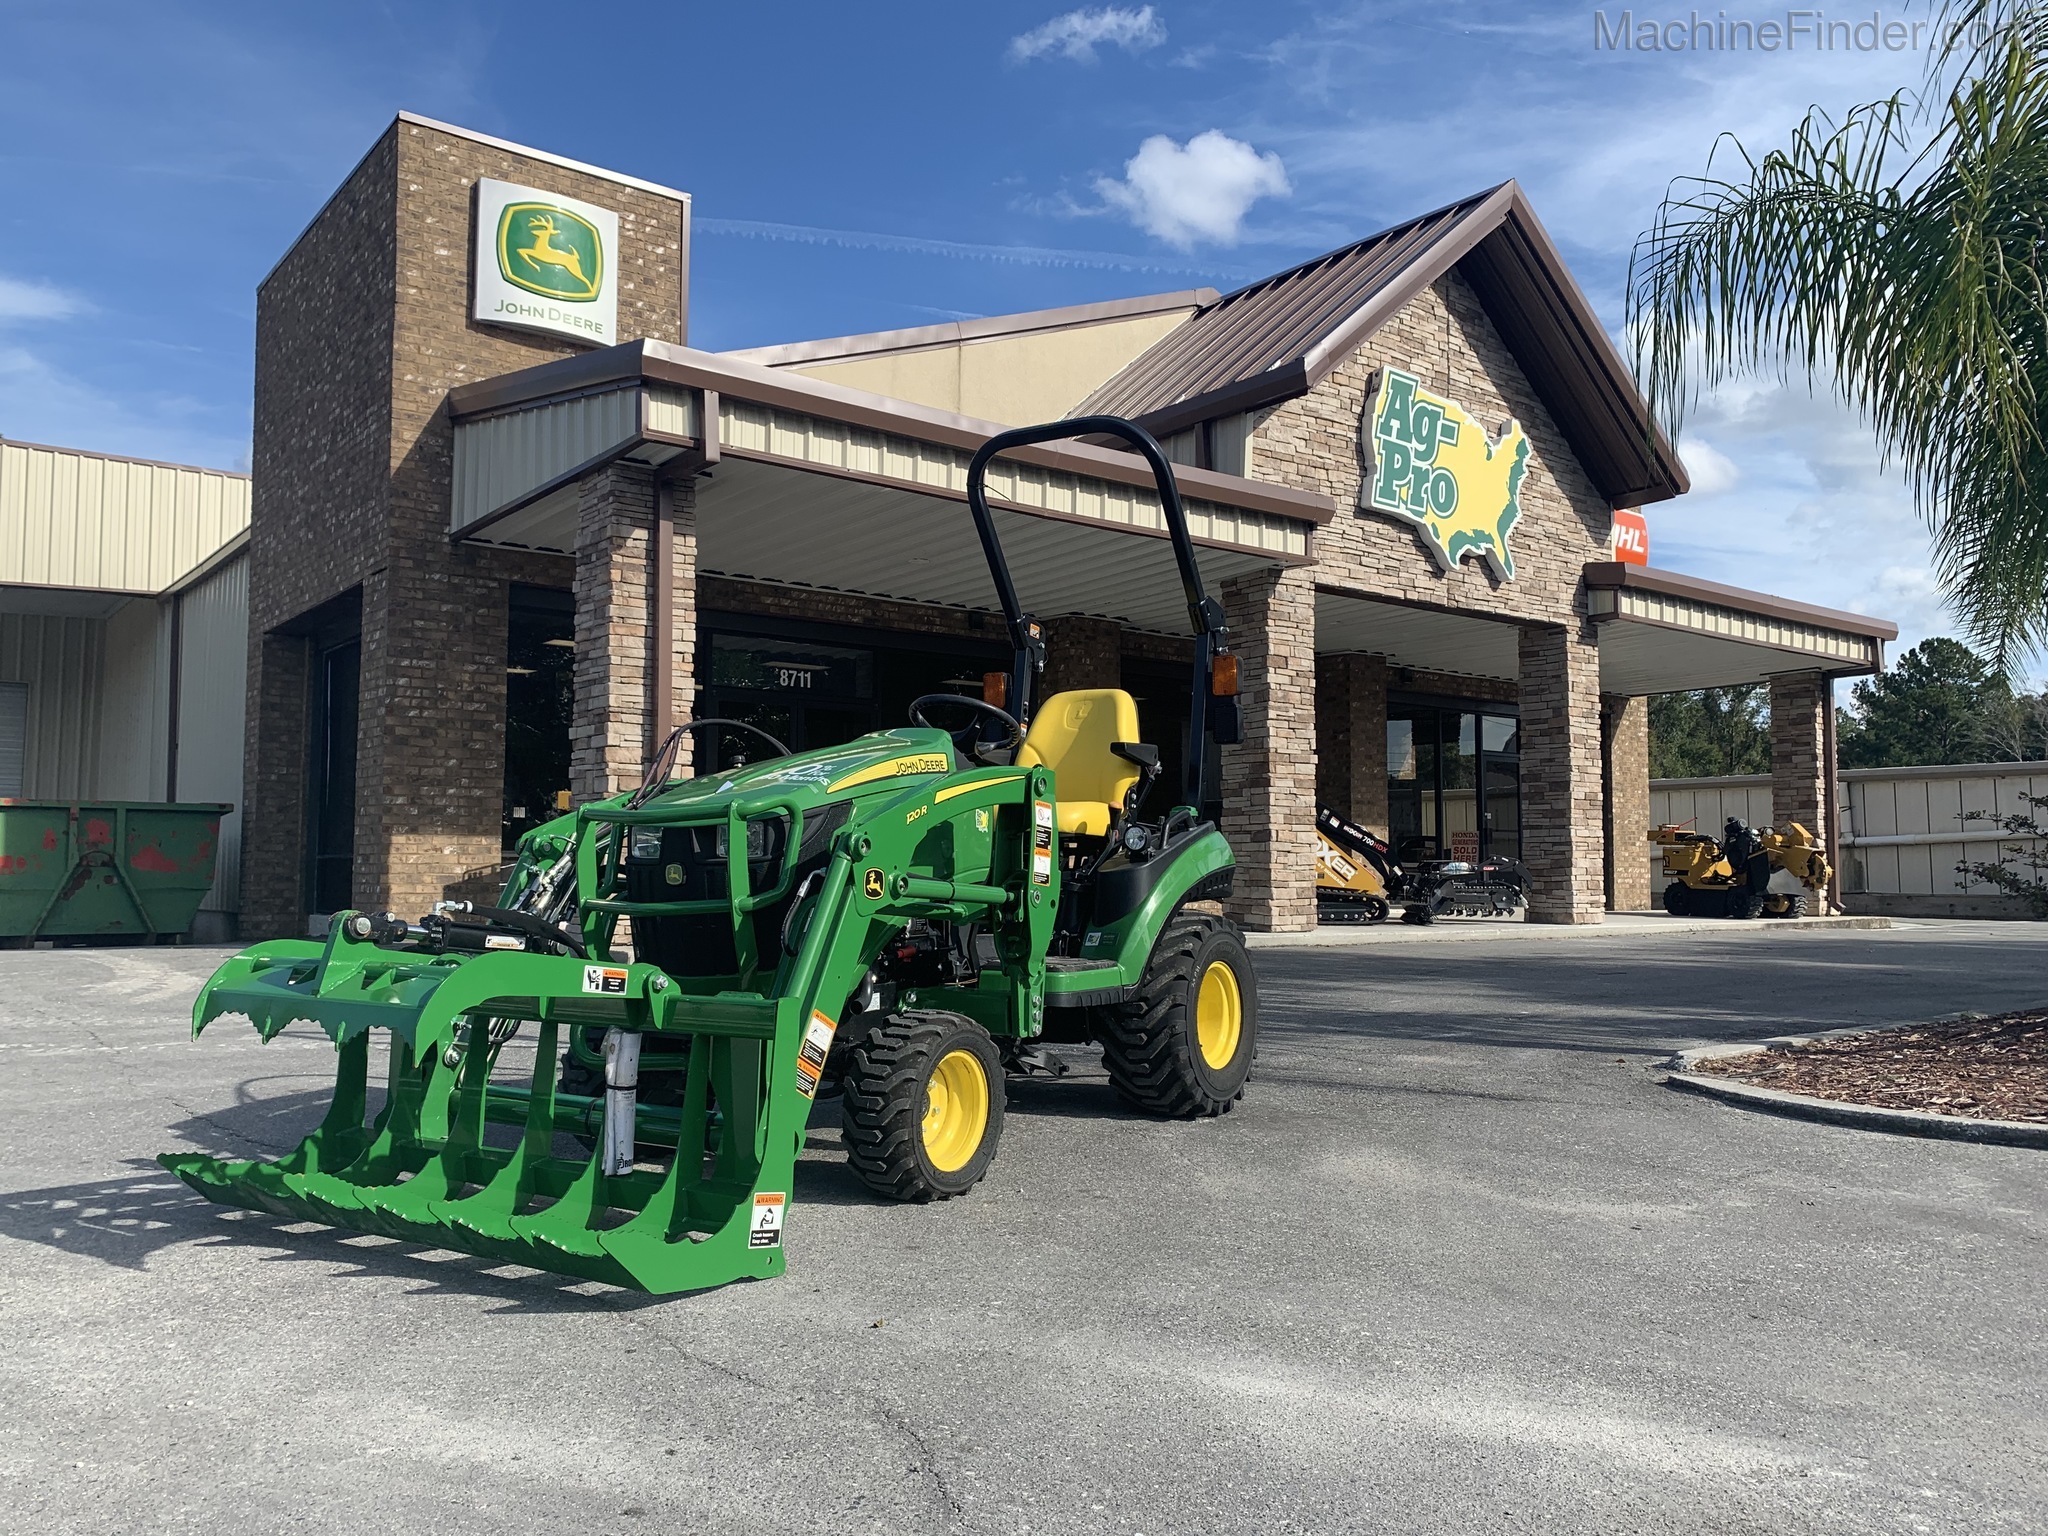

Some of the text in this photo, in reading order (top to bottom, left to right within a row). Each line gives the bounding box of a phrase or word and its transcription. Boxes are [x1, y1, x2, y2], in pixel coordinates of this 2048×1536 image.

[494, 299, 604, 334] JOHN DEERE
[1375, 370, 1460, 466] Ag-
[1373, 438, 1459, 519] Pro
[780, 669, 811, 688] 8711
[895, 758, 946, 775] JOHN DEERE
[1453, 846, 1478, 855] SOLD
[1453, 854, 1478, 863] HERE
